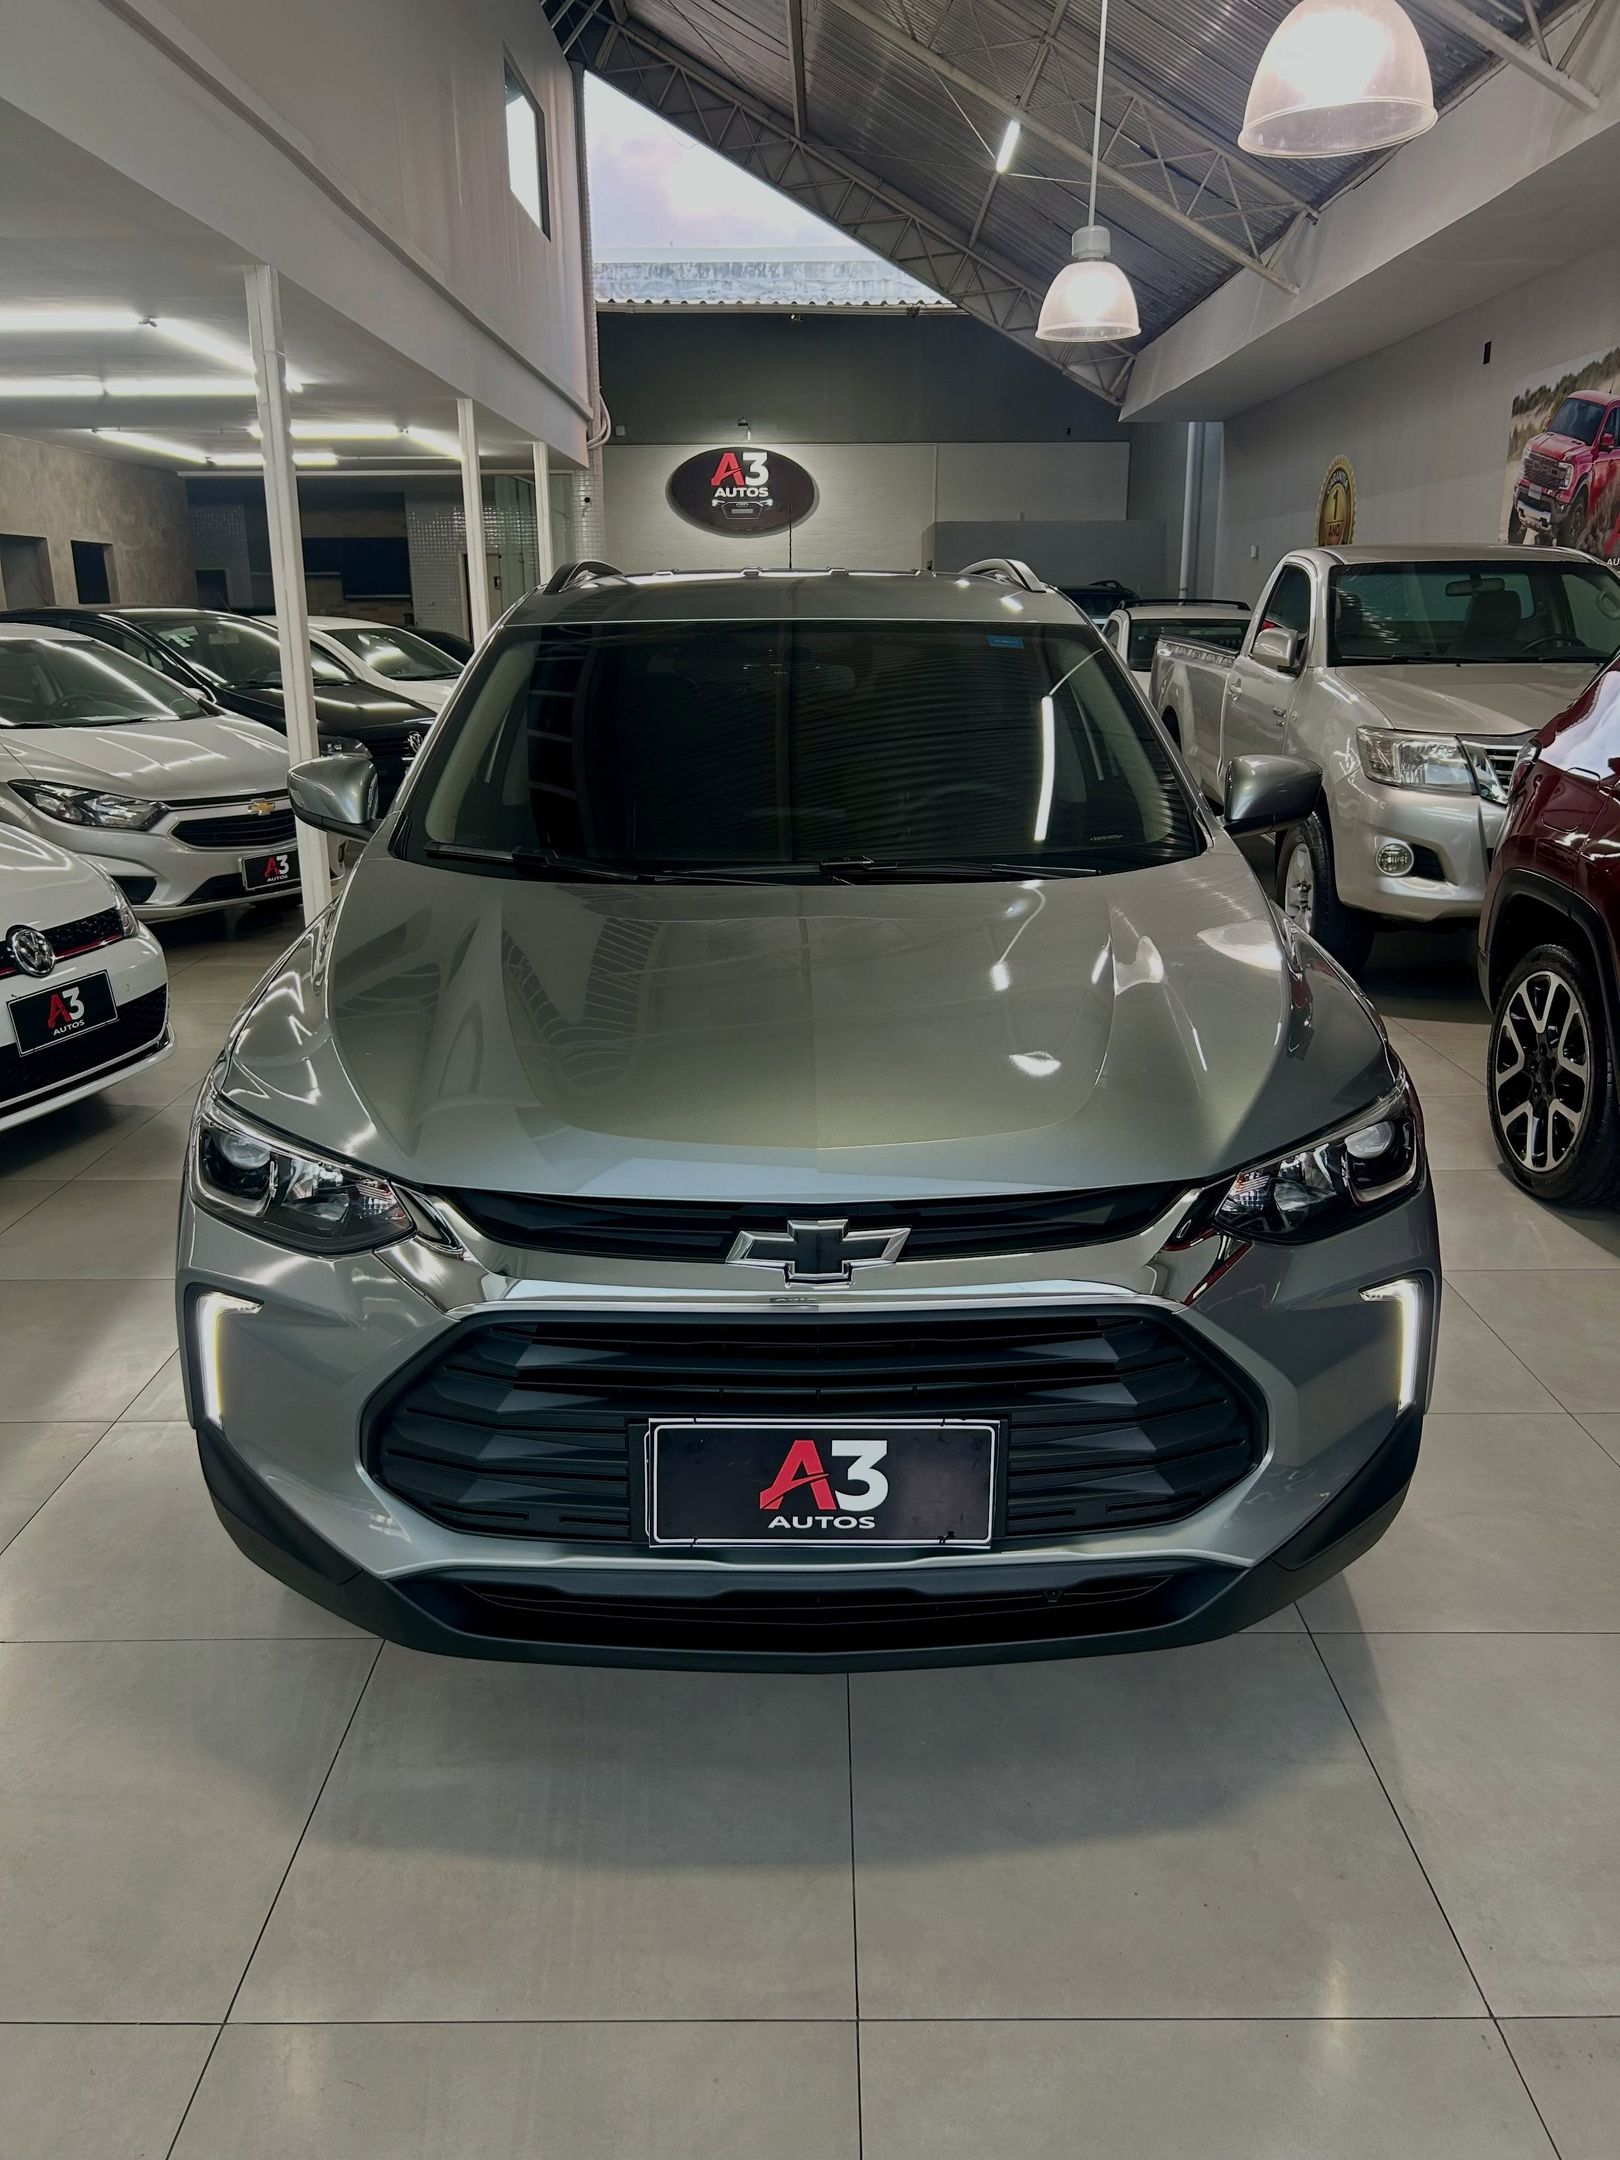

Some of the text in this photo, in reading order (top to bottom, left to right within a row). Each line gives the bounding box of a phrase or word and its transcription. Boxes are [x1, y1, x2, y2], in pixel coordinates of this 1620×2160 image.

[710, 452, 770, 487] A3
[714, 486, 770, 498] AUTOS
[264, 854, 290, 877] A3
[267, 874, 289, 883] AUTOS
[47, 986, 85, 1029] A3
[53, 1019, 86, 1037] AUTOS
[759, 1439, 889, 1512] A3
[767, 1515, 876, 1529] AUTOS
